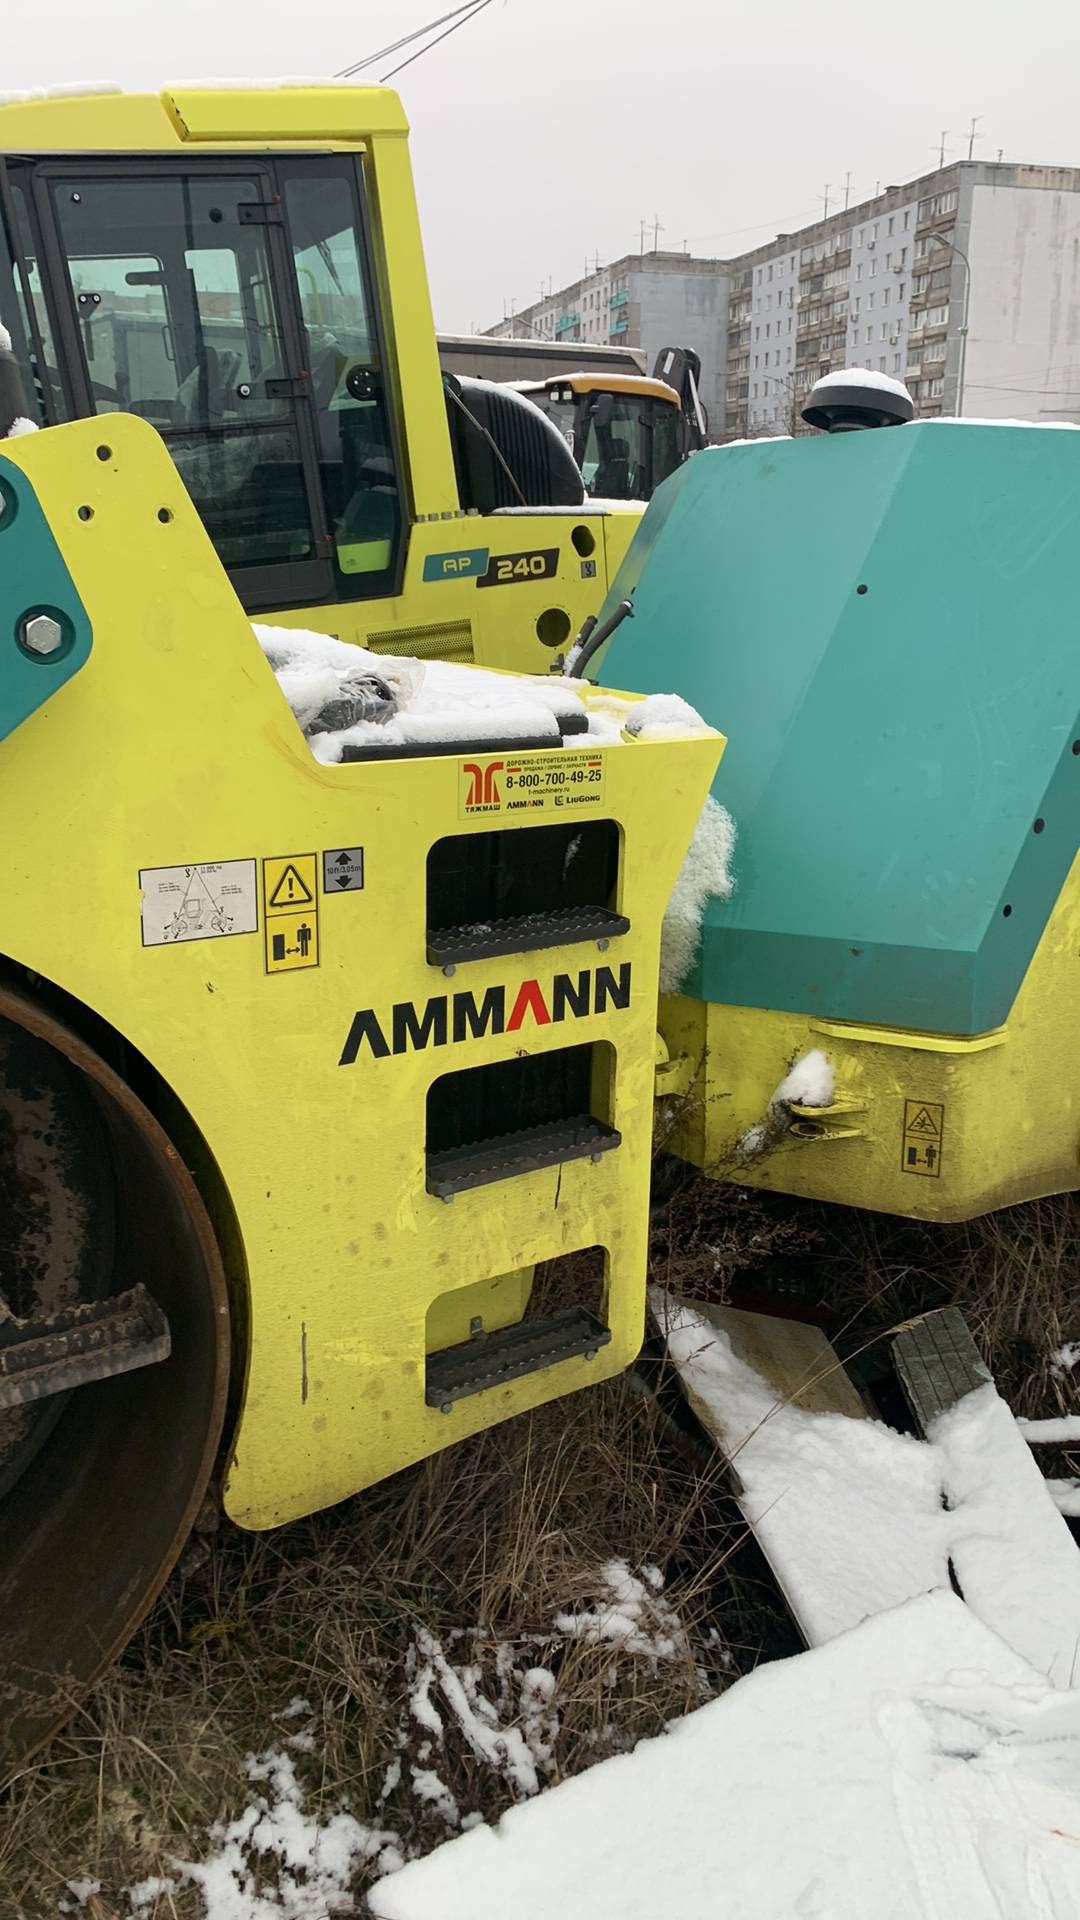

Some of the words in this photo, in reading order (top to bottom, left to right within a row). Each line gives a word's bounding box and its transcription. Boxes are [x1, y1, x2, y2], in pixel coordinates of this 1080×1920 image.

[442, 557, 471, 573] AP
[497, 556, 546, 580] 240
[506, 755, 578, 767] ДОРОЖНО-СТРОИТЕЛЬНАЯ
[579, 753, 603, 761] ТЕХНИКА
[506, 769, 602, 789] 8-800-700-49-25
[528, 787, 570, 796] t-machinery.ru
[465, 804, 501, 813] ТЯЖМАШ
[506, 799, 544, 810] AMMANN
[338, 962, 632, 1066] AMMANN
